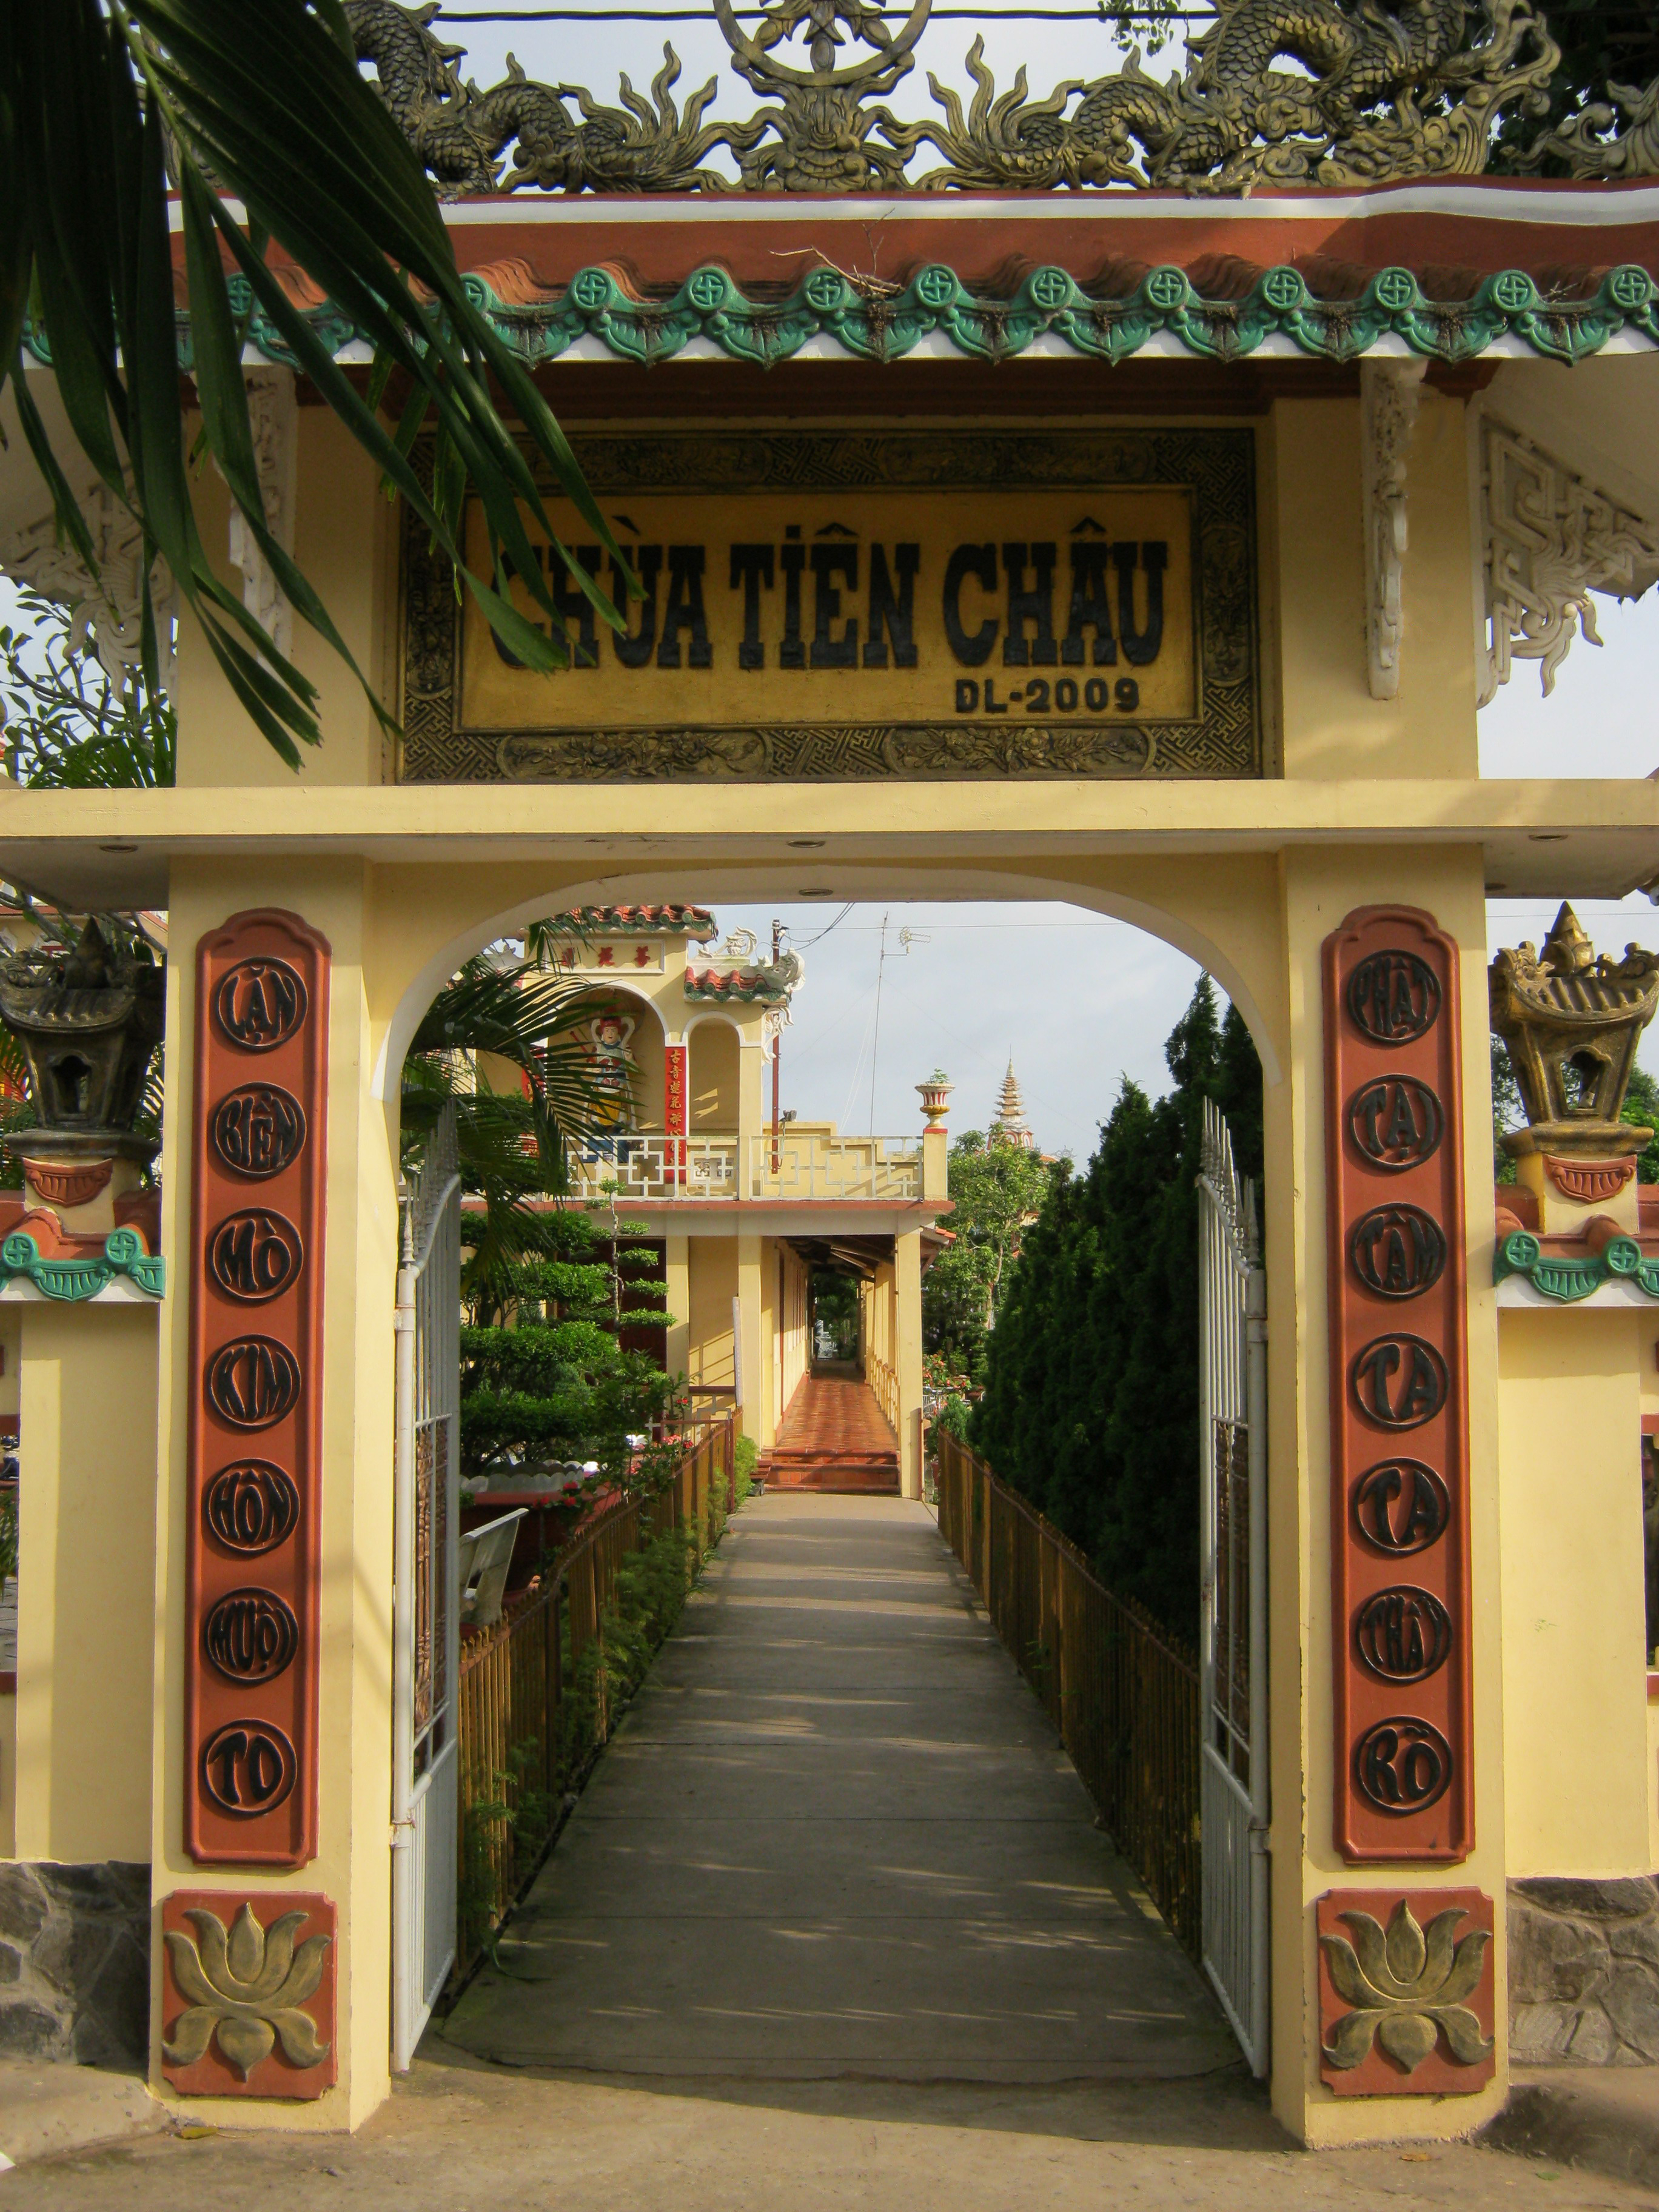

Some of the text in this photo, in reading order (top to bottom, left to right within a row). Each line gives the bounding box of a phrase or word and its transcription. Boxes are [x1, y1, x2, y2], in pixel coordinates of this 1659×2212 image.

[490, 515, 712, 669] CHÙA
[942, 515, 1168, 669] CHÂU
[225, 967, 297, 1044] LẶN
[1356, 956, 1435, 1036] PHẬT
[1356, 1082, 1435, 1161] TẠI
[220, 1217, 291, 1292] MÒ
[1358, 1211, 1440, 1289] TÂM
[218, 1343, 292, 1419] KIM
[1358, 1342, 1438, 1420] TA
[215, 1469, 290, 1543] HÔN
[1359, 1467, 1439, 1546] TA
[209, 1731, 284, 1805] TO
[1365, 1726, 1443, 1803] RÕ
